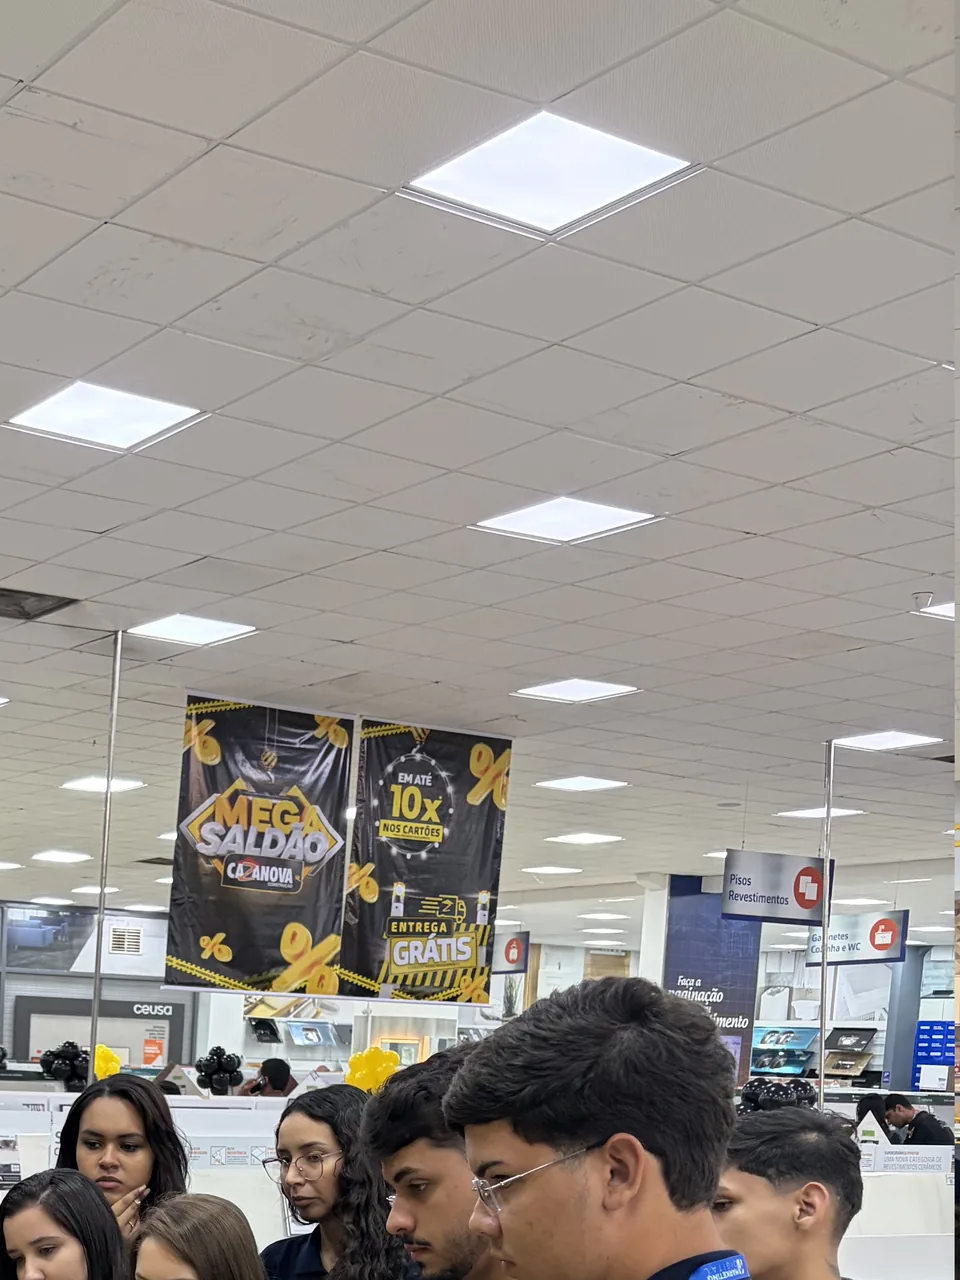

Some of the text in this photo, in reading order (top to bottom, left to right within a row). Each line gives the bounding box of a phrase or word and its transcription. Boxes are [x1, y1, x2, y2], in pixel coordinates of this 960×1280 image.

[398, 772, 432, 786] EM ATÉ
[214, 795, 323, 835] MEGA
[383, 823, 401, 834] NOS
[402, 825, 440, 838] CARTÕES
[195, 821, 329, 863] SALDÃO
[226, 861, 293, 883] CAZANOVA
[729, 873, 751, 886] Pisos
[728, 890, 789, 905] Revestimentos
[391, 921, 447, 933] ENTREGA
[811, 932, 849, 942] Ganetes
[393, 933, 472, 966] GRÁTIS
[848, 942, 861, 951] WC
[677, 975, 695, 988] Faça
[133, 1003, 173, 1016] ceusa
